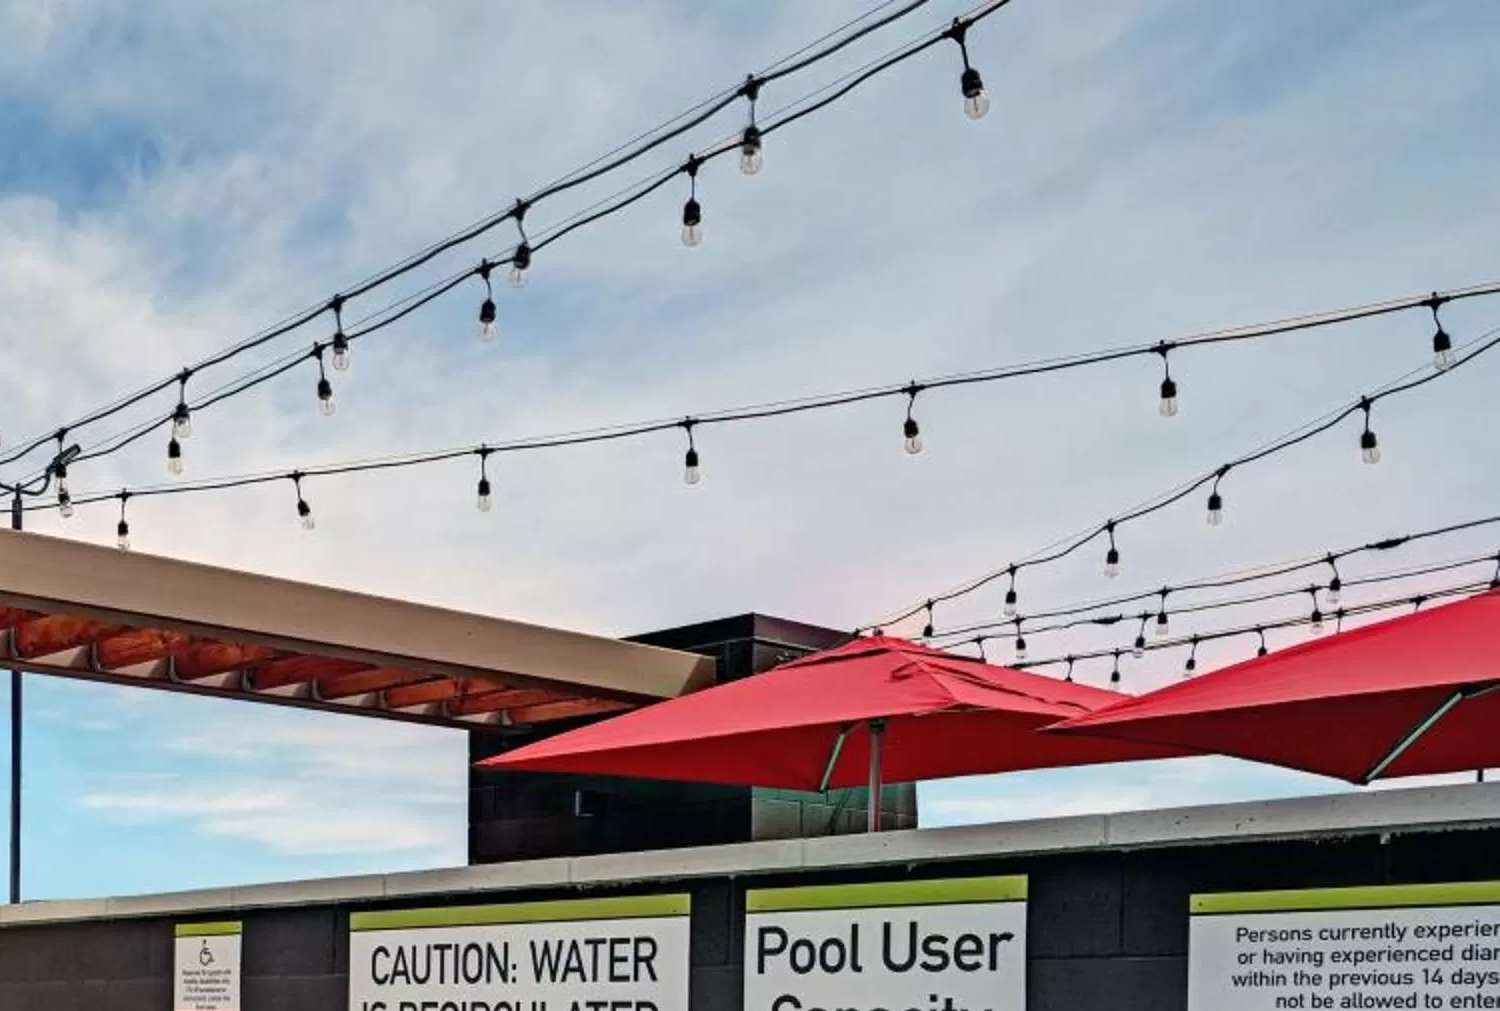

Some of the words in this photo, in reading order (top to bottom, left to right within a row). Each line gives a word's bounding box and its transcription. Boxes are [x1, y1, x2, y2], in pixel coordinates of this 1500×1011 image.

[1235, 927, 1312, 943] Persons
[1319, 922, 1408, 944] currently
[757, 924, 862, 975] Pool
[882, 921, 1014, 973] User
[1237, 952, 1255, 965] or
[1263, 948, 1324, 968] having
[1331, 945, 1453, 968] experienced
[371, 943, 517, 985] CAUTION:
[530, 936, 658, 983] WATER
[1231, 971, 1287, 987] within
[1293, 971, 1323, 987] the
[1329, 970, 1415, 990] previous
[1422, 968, 1444, 985] 14
[1451, 968, 1499, 989] days
[1275, 994, 1305, 1009] not
[1311, 993, 1334, 1009] be
[1340, 992, 1417, 1009] allowed
[1425, 993, 1443, 1009] to
